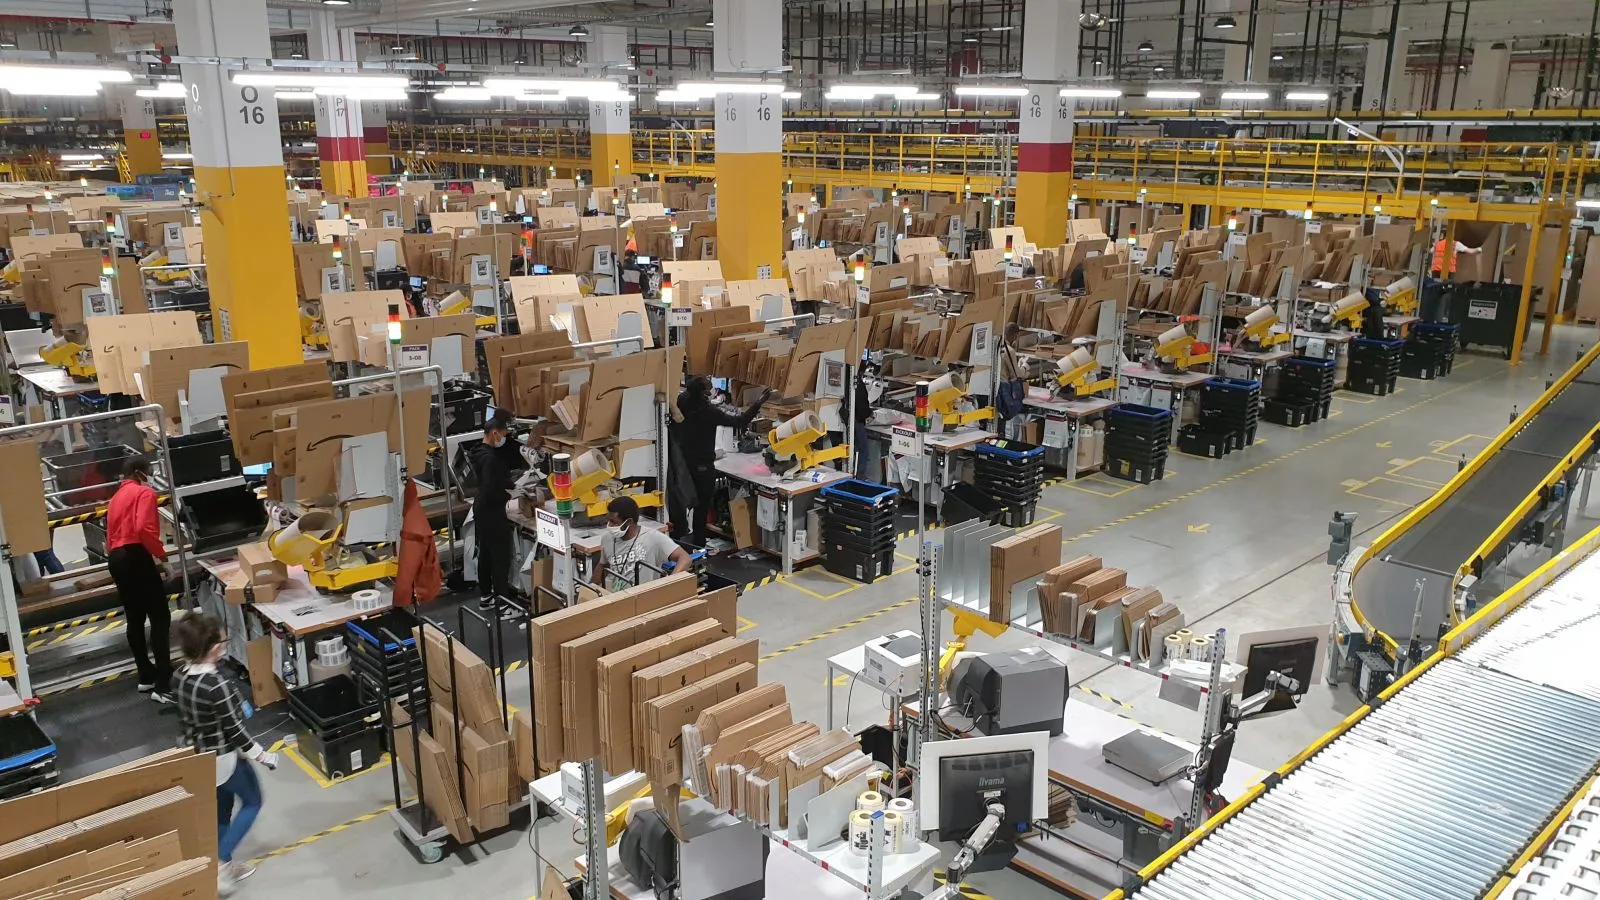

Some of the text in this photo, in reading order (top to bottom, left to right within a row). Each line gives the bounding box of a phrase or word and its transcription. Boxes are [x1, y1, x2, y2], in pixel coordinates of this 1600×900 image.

[240, 85, 258, 103] O
[759, 93, 767, 105] P
[336, 98, 342, 107] P
[1031, 95, 1040, 105] Q
[239, 106, 264, 124] 16
[336, 108, 344, 117] 17
[614, 108, 622, 117] 17
[724, 108, 737, 121] 16
[757, 107, 770, 121] 16
[1030, 107, 1041, 118] 16
[1058, 108, 1067, 119] 16
[895, 429, 913, 437] KICKOUT
[539, 512, 556, 524] KICKOUT
[542, 527, 555, 538] 1-05
